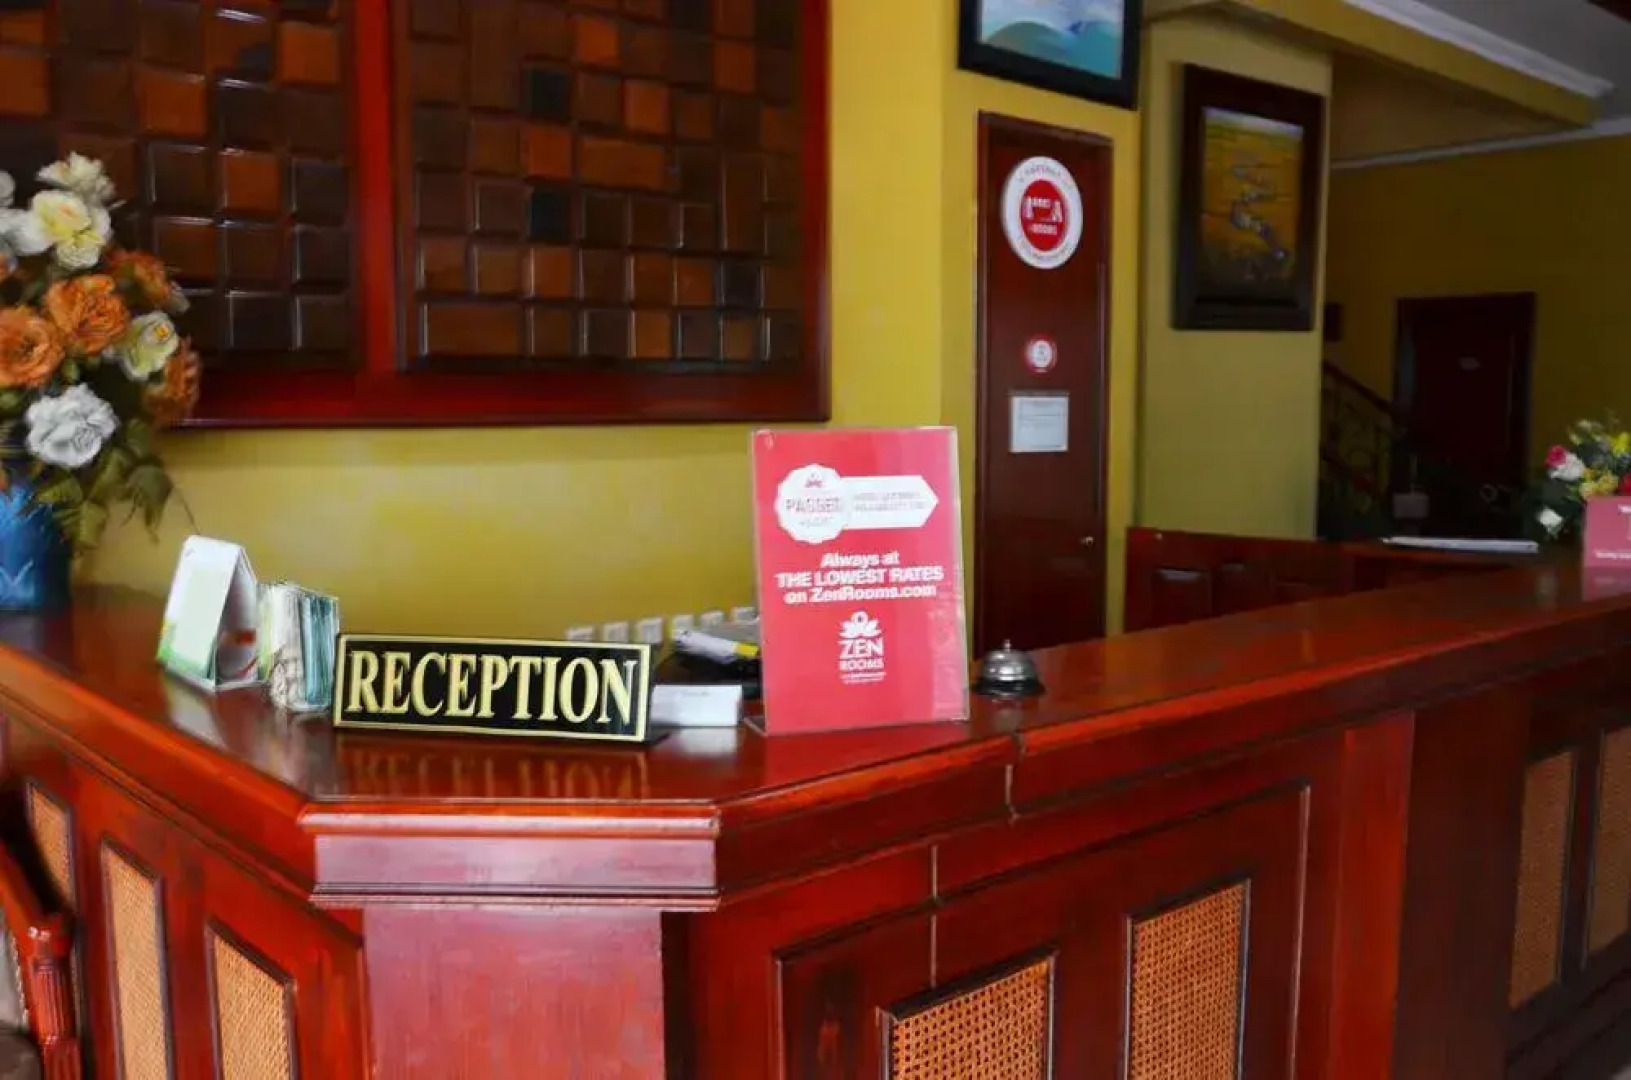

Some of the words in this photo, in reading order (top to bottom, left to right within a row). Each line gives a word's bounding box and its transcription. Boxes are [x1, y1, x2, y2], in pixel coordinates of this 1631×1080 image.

[821, 552, 879, 568] Always
[882, 551, 899, 565] at
[774, 572, 812, 588] THE
[814, 569, 885, 587] LOWEST
[889, 566, 944, 582] RATES
[784, 591, 807, 604] on
[809, 585, 937, 603] ZenRooms.com
[838, 638, 884, 660] ZEN
[839, 659, 884, 672] ROOMS
[345, 650, 639, 725] RECEPTION
